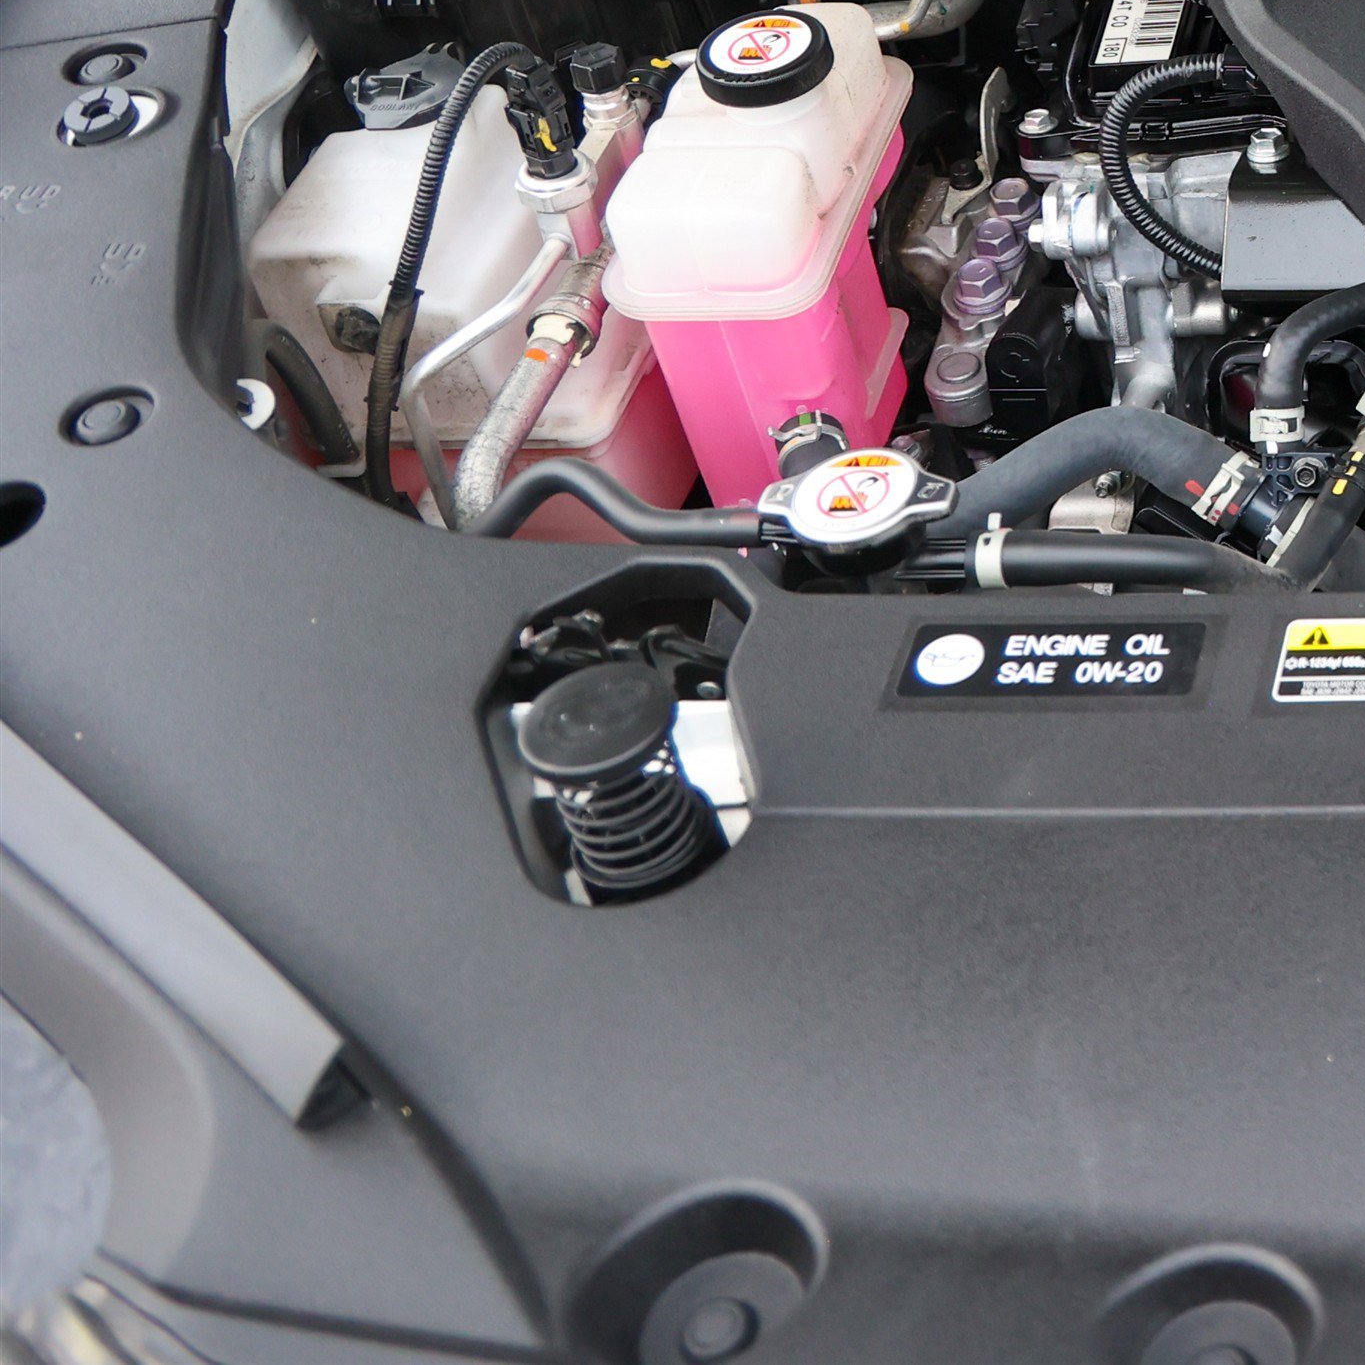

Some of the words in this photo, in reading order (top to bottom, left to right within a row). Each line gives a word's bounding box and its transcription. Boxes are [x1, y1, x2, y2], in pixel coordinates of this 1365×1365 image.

[1003, 634, 1110, 656] ENGINE
[1124, 634, 1171, 656] OIL
[996, 661, 1059, 684] SAE
[1074, 661, 1164, 684] 0W-20
